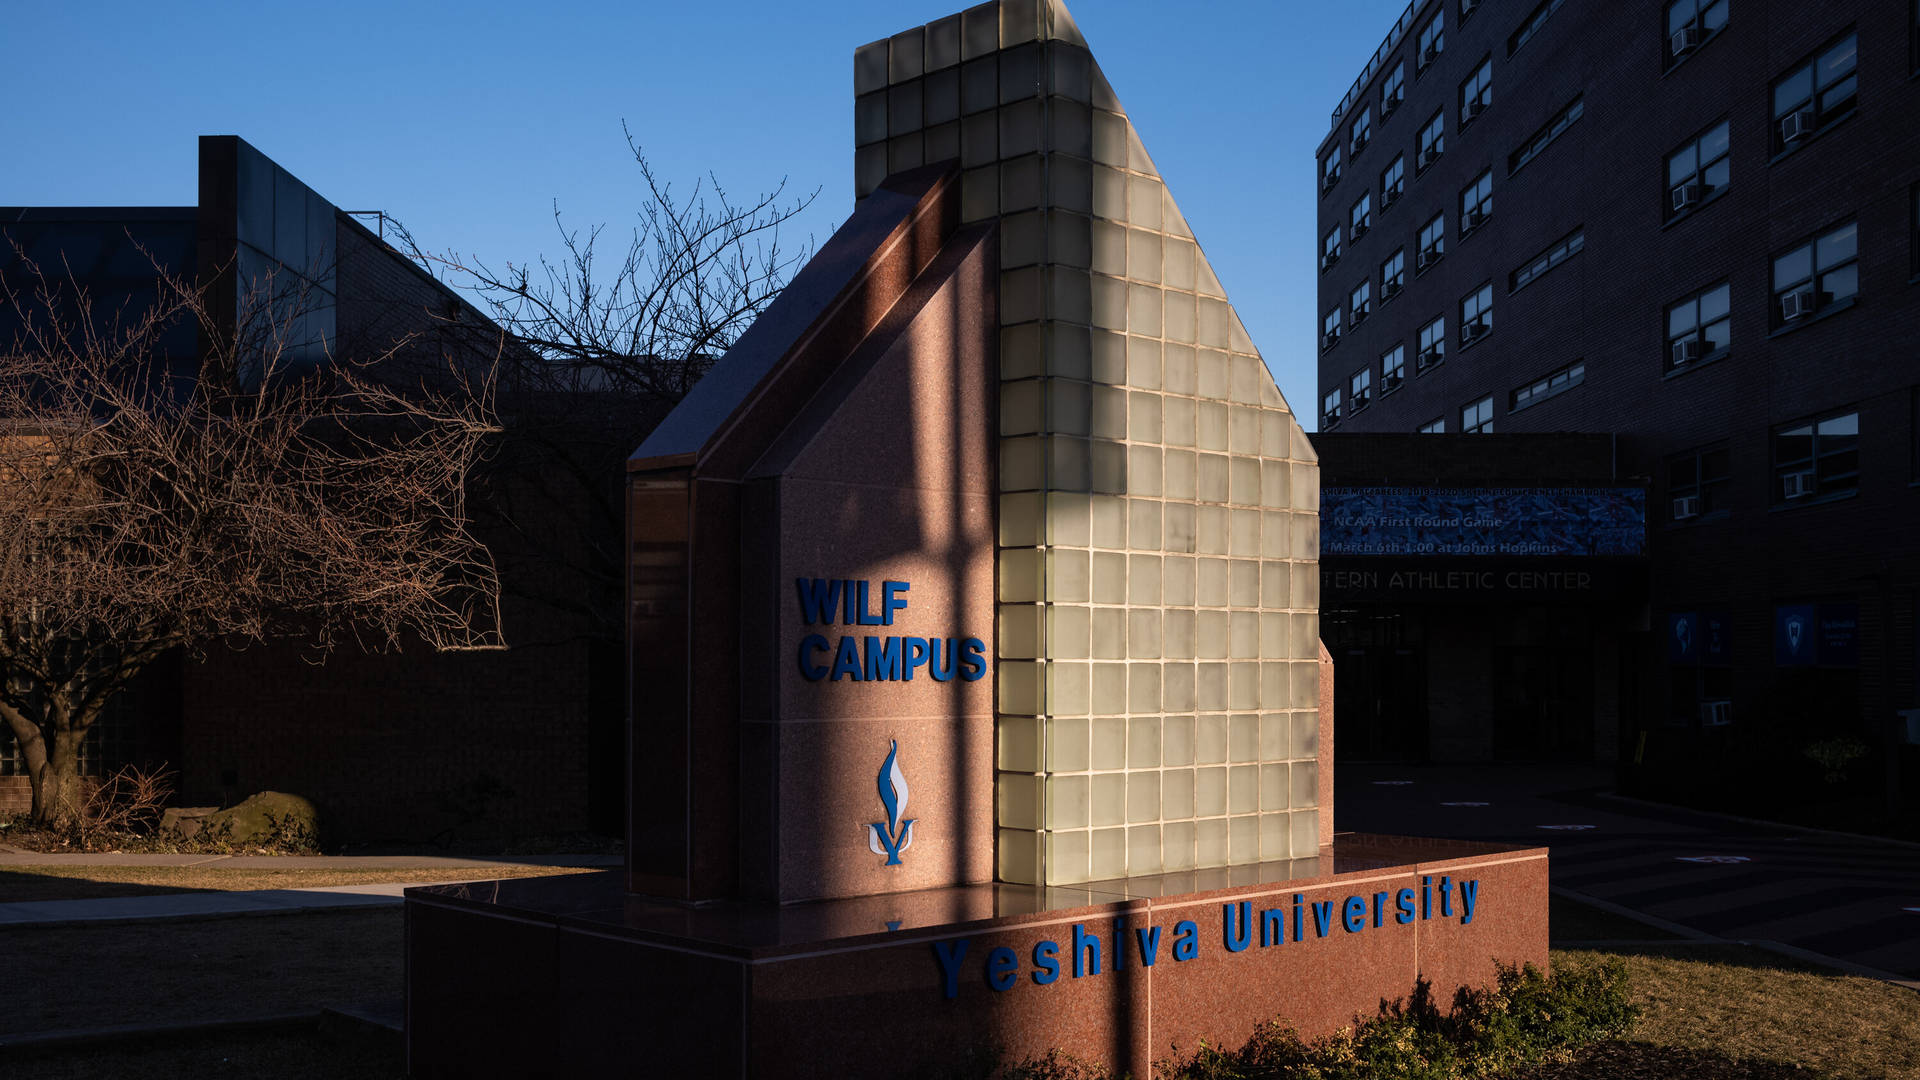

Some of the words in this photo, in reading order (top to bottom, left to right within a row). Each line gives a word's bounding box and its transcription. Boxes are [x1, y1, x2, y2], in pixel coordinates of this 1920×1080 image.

[1333, 517, 1376, 528] NCAA
[1379, 516, 1410, 528] First
[1414, 516, 1459, 528] Round
[1463, 516, 1503, 528] Game
[1330, 542, 1373, 554] March
[1376, 542, 1400, 554] 6th
[1438, 543, 1453, 554] at
[1455, 542, 1496, 554] Johns
[1499, 542, 1557, 556] Hopkins
[1389, 571, 1495, 590] ATHLETIC
[1504, 572, 1592, 590] CENTER
[796, 578, 910, 626] WILF
[799, 634, 987, 682] CAMPUS
[931, 917, 1198, 999] Yeshiva
[1223, 876, 1478, 953] University
